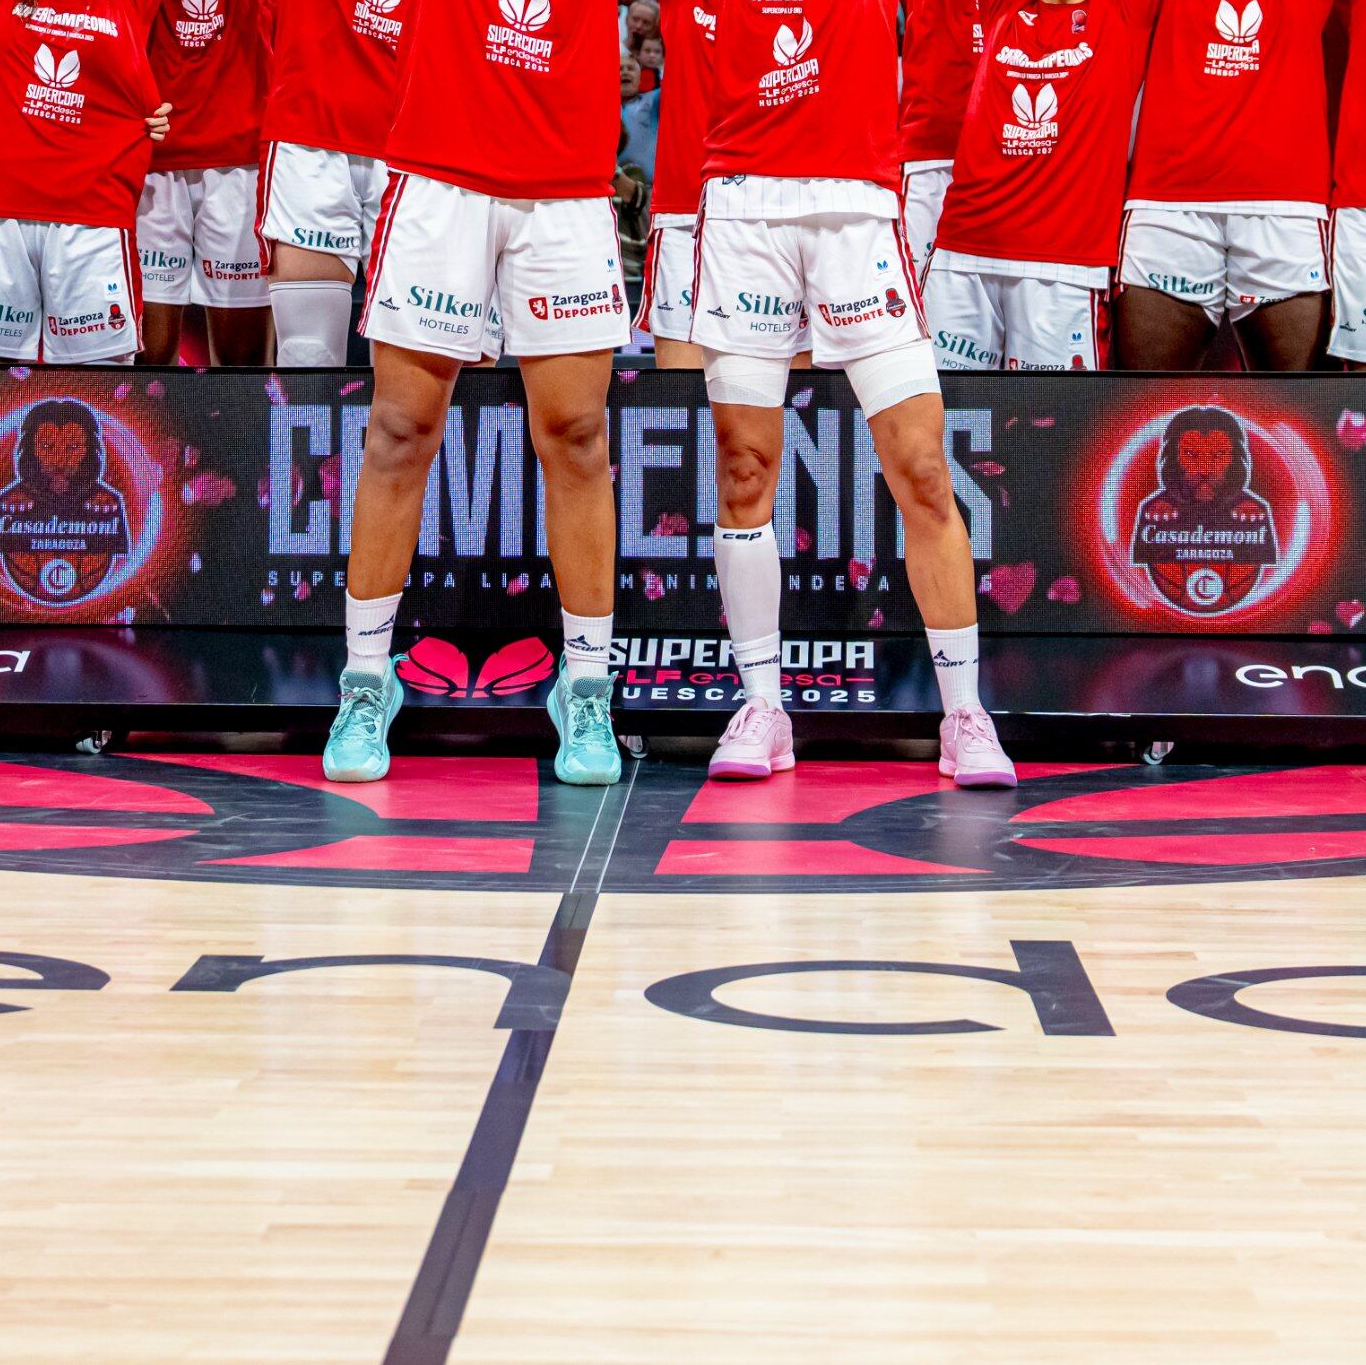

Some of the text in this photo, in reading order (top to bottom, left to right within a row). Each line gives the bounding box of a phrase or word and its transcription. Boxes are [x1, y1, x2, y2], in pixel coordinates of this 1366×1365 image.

[487, 25, 553, 58] SUPERCOPA
[486, 53, 521, 67] HUESCA
[506, 48, 542, 64] endesa
[759, 58, 819, 89] SUPERCOPA
[26, 83, 85, 108] SUPERCOPA
[22, 106, 56, 119] HUESCA
[215, 260, 259, 272] Zaragoza
[216, 272, 260, 281] DEPORTE
[1149, 273, 1214, 294] Silken
[407, 285, 482, 318] Silken
[552, 289, 609, 306] Zaragoza
[736, 291, 803, 316] Silken
[830, 295, 879, 313] Zaragoza
[58, 311, 104, 326] Zaragoza
[553, 304, 611, 320] DEPORTE
[833, 308, 885, 327] DEPORTE
[60, 323, 106, 336] DEPORTE
[419, 316, 470, 334] HOTELES
[750, 322, 791, 333] HOTELES
[934, 330, 998, 365] Silken
[722, 531, 762, 542] cep
[1141, 524, 1268, 544] Casademont
[789, 574, 889, 591] NDESA
[608, 637, 874, 669] SUPEROPA
[626, 670, 841, 686] LF enesa
[781, 689, 875, 703] 2025
